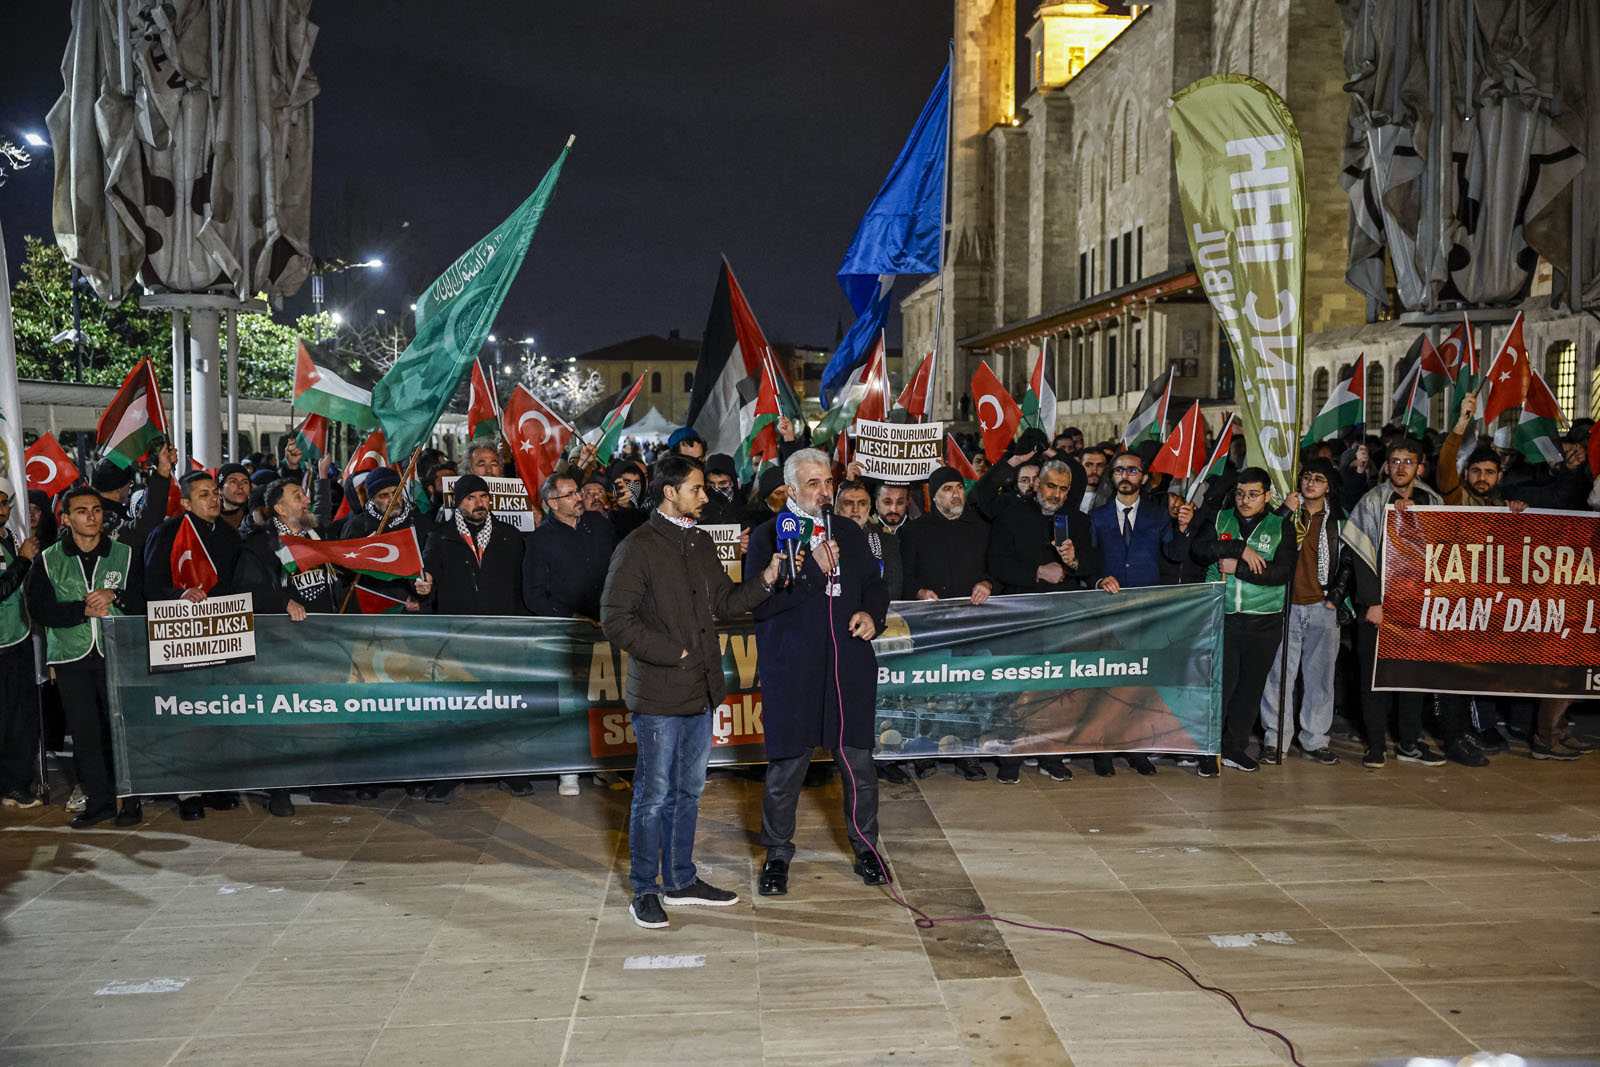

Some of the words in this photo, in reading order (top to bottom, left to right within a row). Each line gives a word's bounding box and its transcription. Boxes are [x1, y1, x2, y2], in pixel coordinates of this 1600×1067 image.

[861, 424, 888, 439] KUDÜS
[890, 427, 938, 440] ONURUMUZ
[859, 438, 908, 458] MESCİD-İ
[909, 442, 938, 458] AKSA
[865, 458, 931, 476] ŞİARIMIZDIR!
[488, 481, 526, 494] URUMUZ
[498, 497, 528, 511] AKSA
[1424, 535, 1511, 584] KATİL
[1521, 536, 1600, 585] İSRA
[154, 604, 189, 619] KUDÜS
[191, 599, 246, 616] ONURUMUZ
[153, 617, 213, 639] MESCİD-İ
[216, 615, 249, 634] AKSA
[163, 637, 242, 661] ŞİARIMIZDIR!
[877, 667, 905, 684] Bu
[911, 663, 985, 684] zulme
[991, 661, 1064, 681] sessiz
[1070, 657, 1149, 677] kalma!
[154, 693, 265, 715] Mescid-i
[271, 693, 338, 713] Aksa
[344, 689, 528, 713] onurumuzdur.
